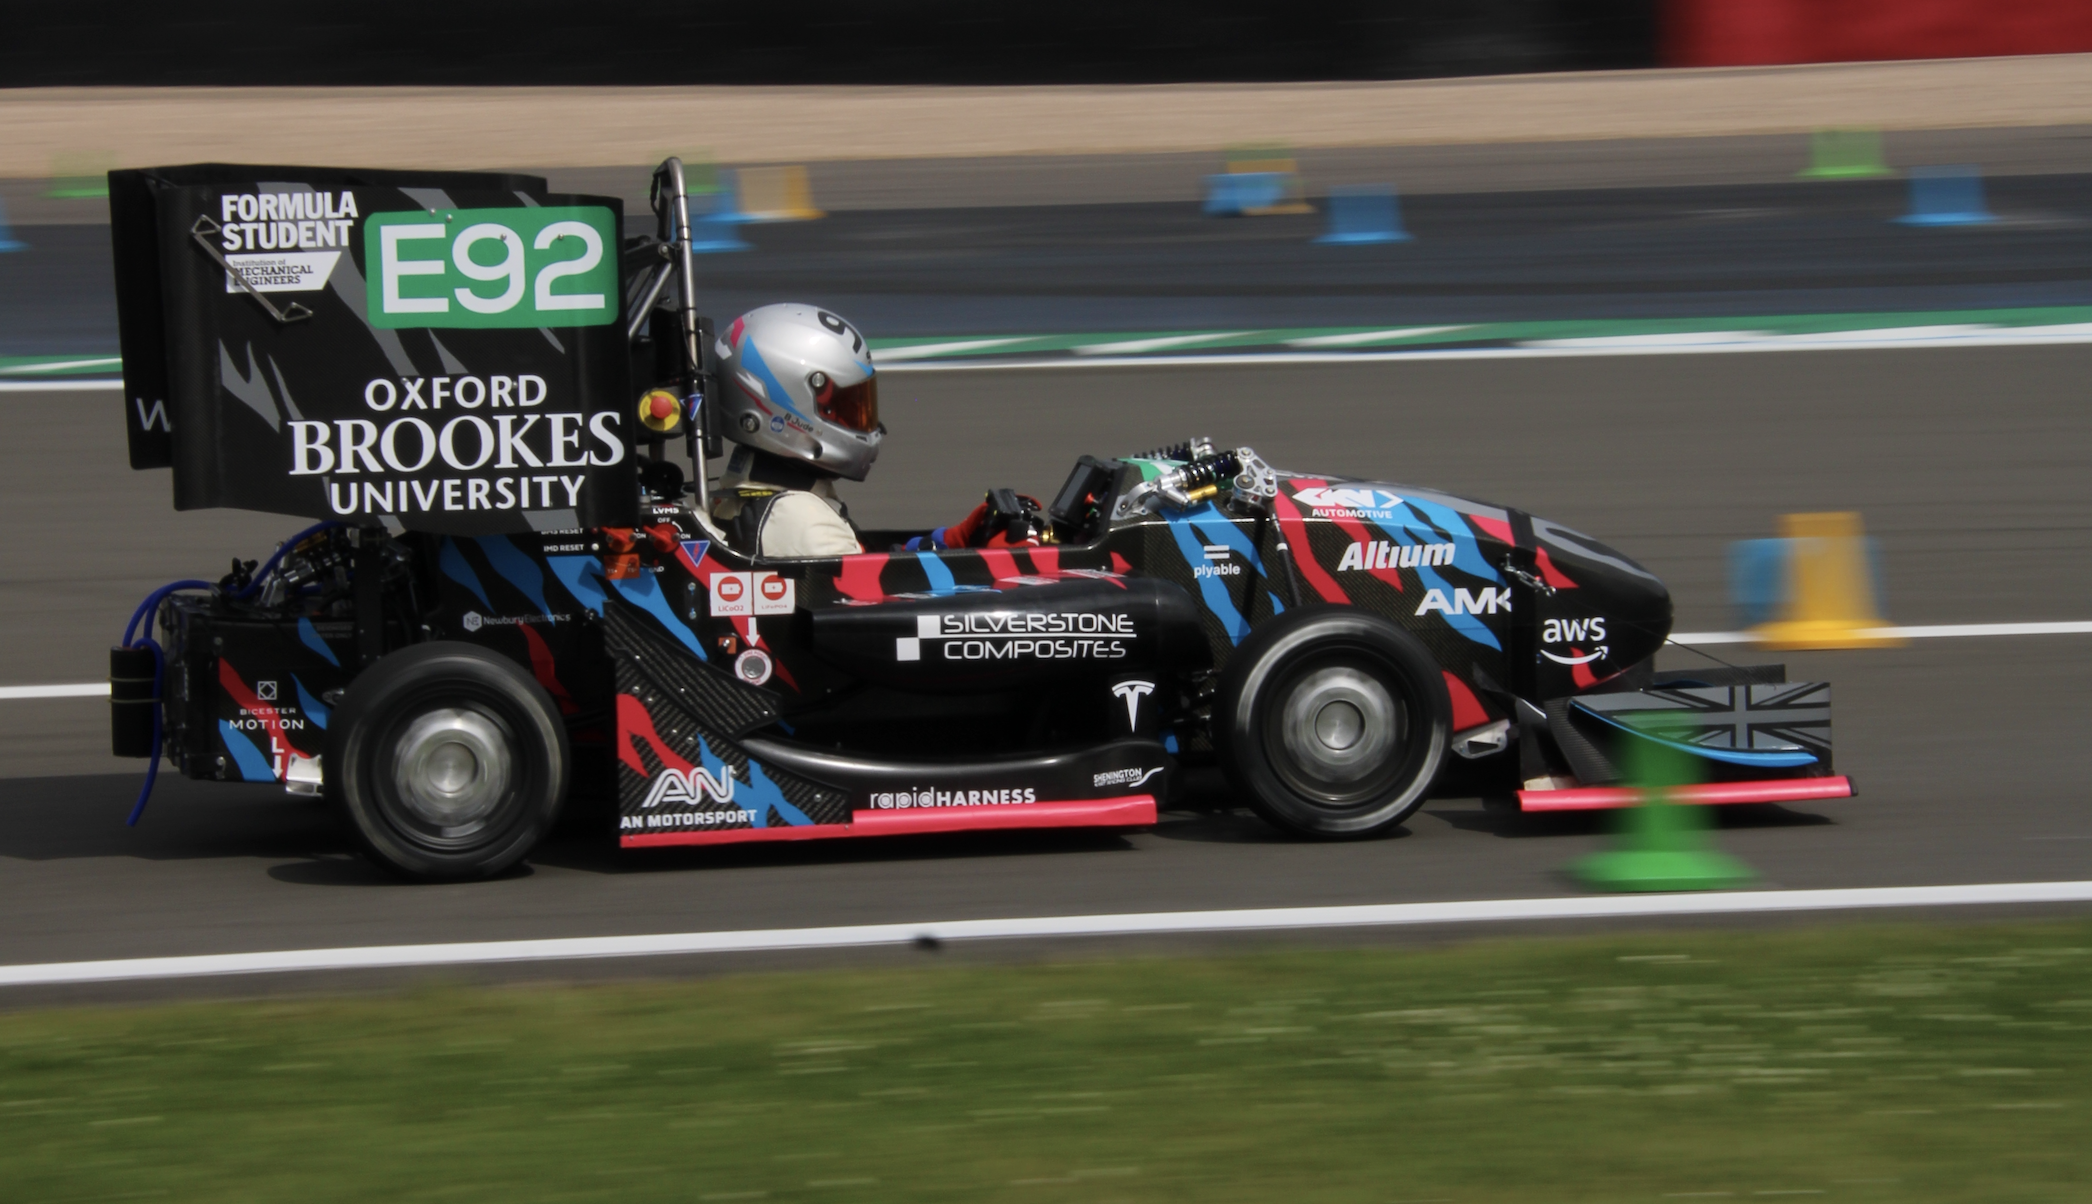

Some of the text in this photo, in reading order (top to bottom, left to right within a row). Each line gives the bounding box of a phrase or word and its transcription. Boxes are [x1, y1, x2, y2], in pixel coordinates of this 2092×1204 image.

[222, 191, 359, 221] FORMULA
[222, 220, 354, 251] STUDENT
[233, 259, 276, 267] Institution
[380, 221, 606, 314] E92
[365, 375, 547, 411] OXFORD
[287, 411, 625, 475] BROOKES
[330, 475, 585, 514] UNIVERSITY
[653, 507, 680, 515] LVMS
[1312, 508, 1393, 519] AUTOMOTIVE
[679, 532, 691, 540] ON
[543, 543, 584, 552] IMD RESET
[1337, 541, 1456, 572] Altium
[1194, 564, 1241, 578] plyable
[1415, 587, 1512, 616] AMK
[943, 612, 1134, 634] SILVERSTONE
[1543, 616, 1606, 643] aws
[944, 640, 1127, 660] COMPOSITES
[240, 707, 296, 716] BICESTER
[229, 719, 304, 730] MOTION
[272, 737, 285, 753] L
[1094, 768, 1142, 781] SHENINGTON
[870, 786, 1036, 811] rapidHARNESS
[621, 809, 757, 828] AN MOTORSPORT
